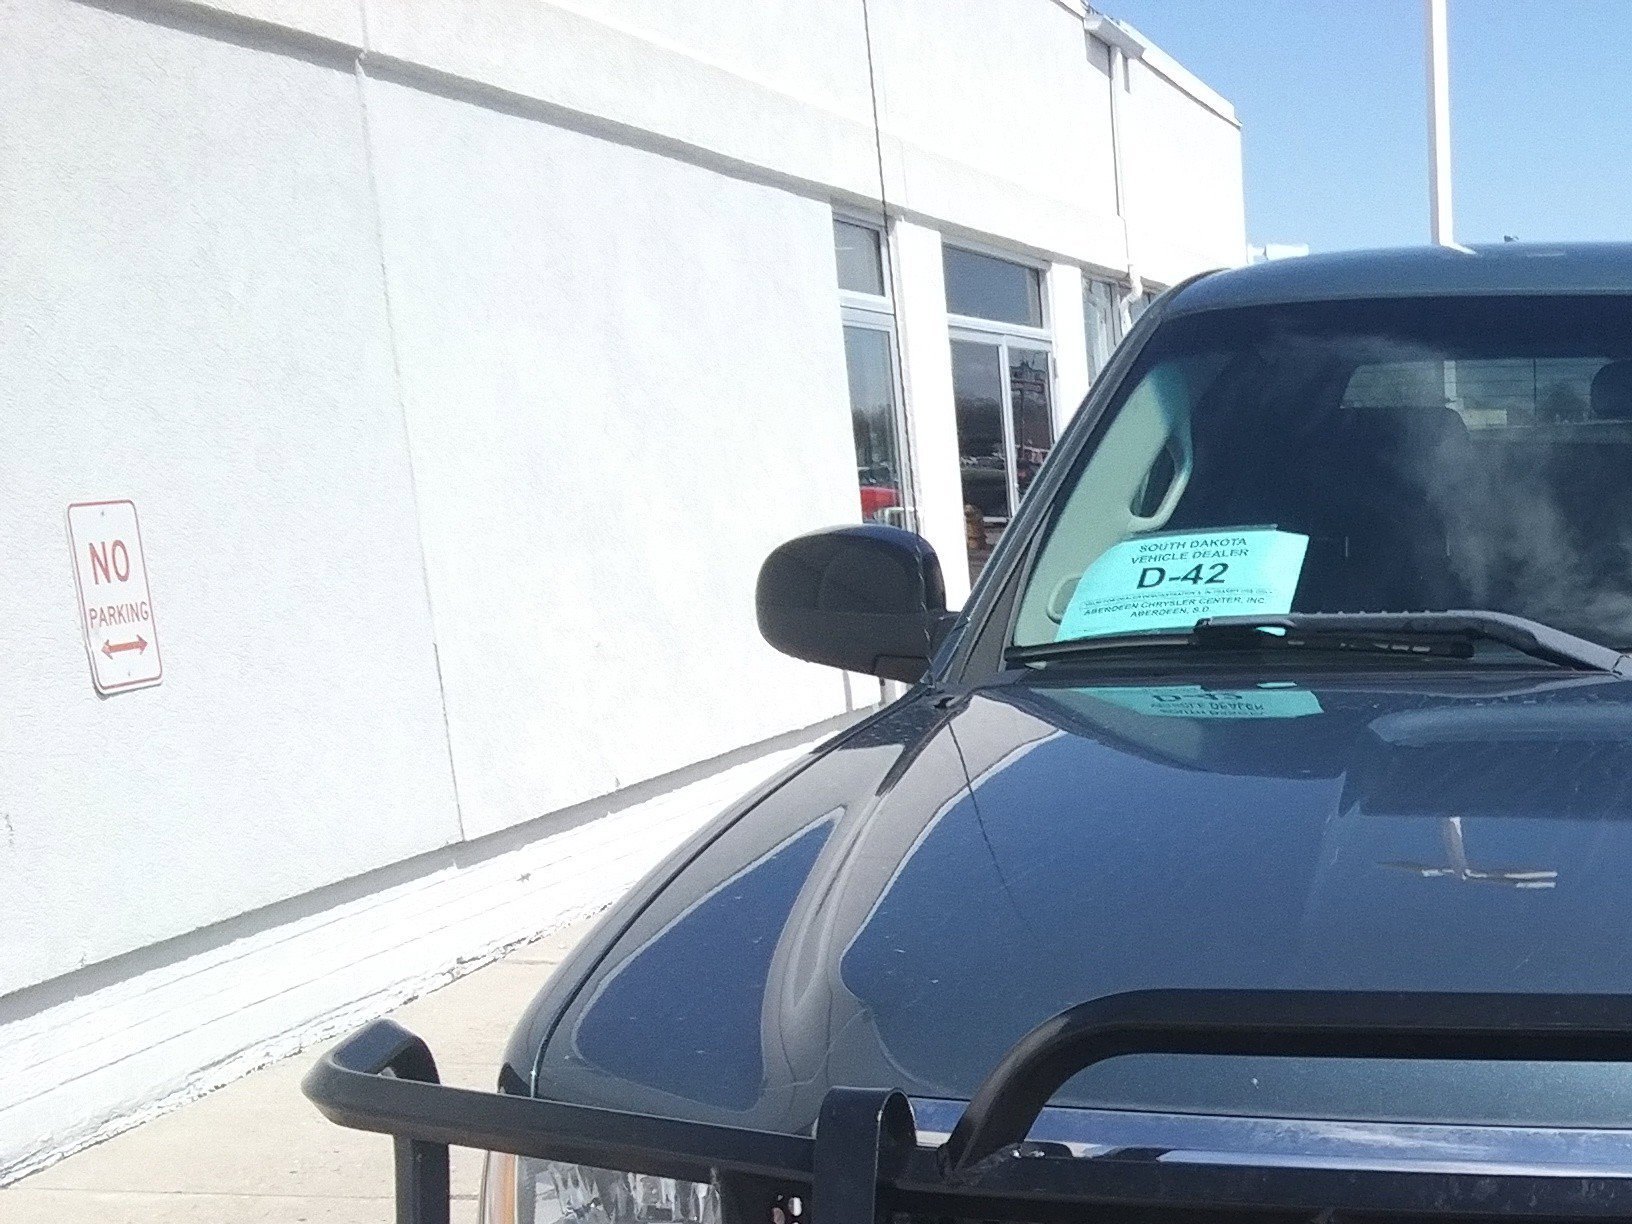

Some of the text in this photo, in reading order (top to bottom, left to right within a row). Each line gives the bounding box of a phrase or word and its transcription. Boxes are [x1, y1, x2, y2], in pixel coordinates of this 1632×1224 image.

[1139, 537, 1247, 553] SOUTH DAKOTA
[88, 539, 130, 585] NO
[1131, 548, 1249, 565] VEHICLE DEALER
[1136, 562, 1230, 590] D-42
[88, 601, 149, 629] PARKING
[1083, 602, 1138, 616] ABERDEEN
[1140, 599, 1196, 609] CHRYSLER
